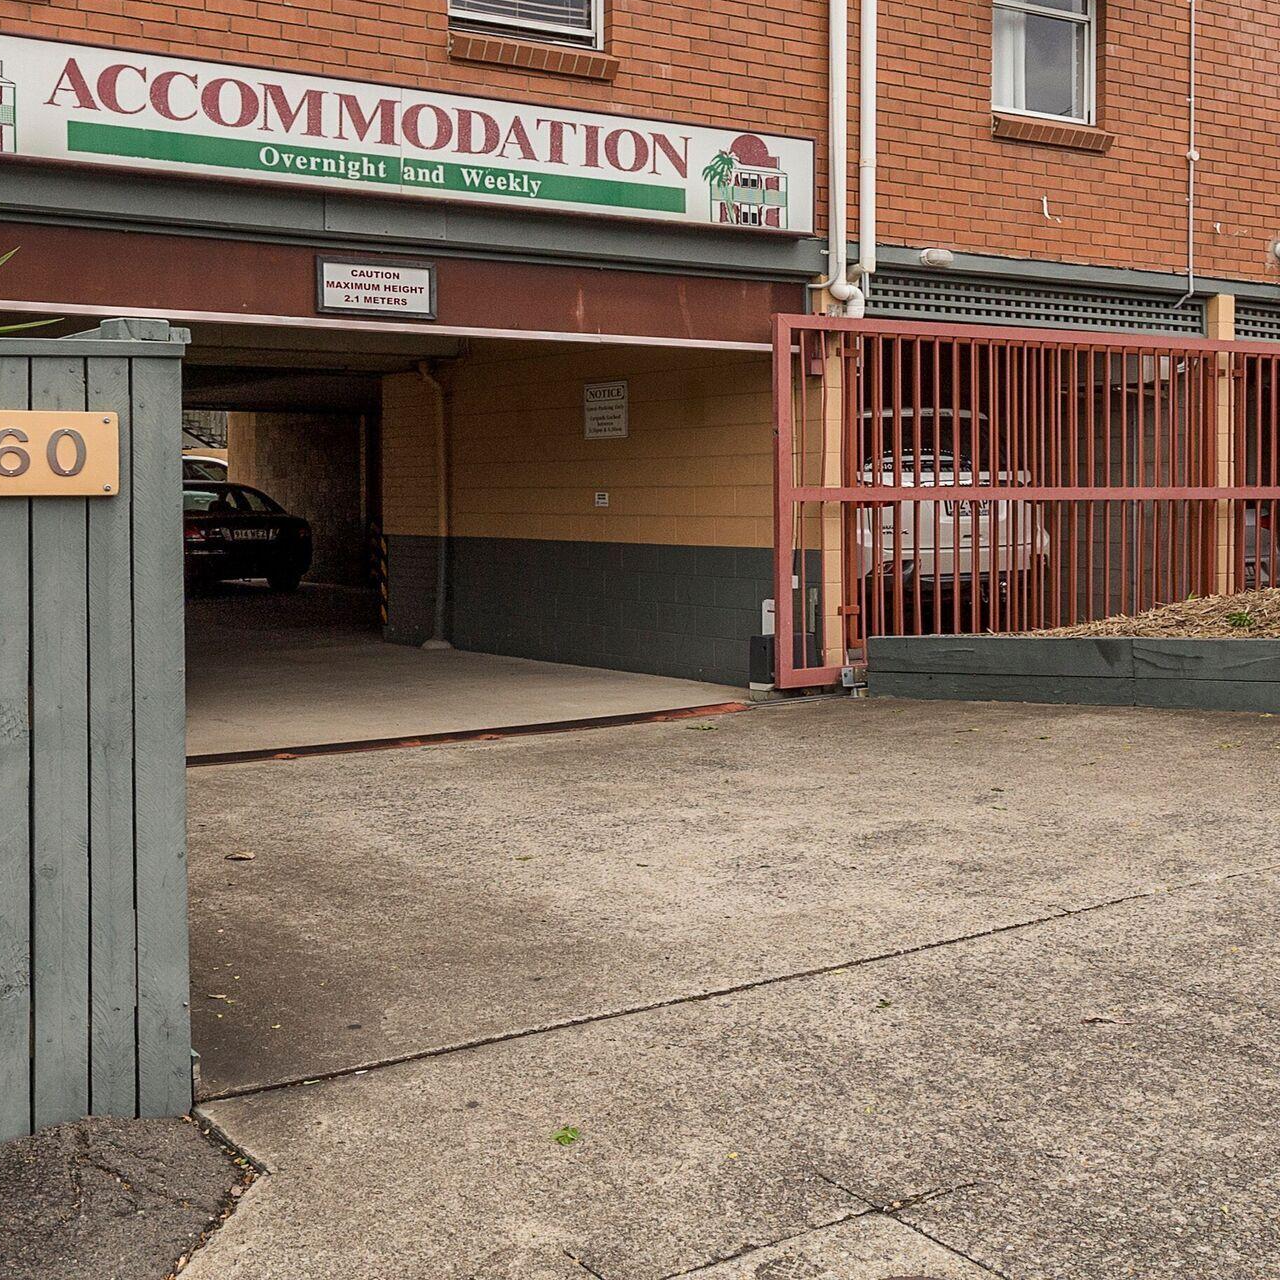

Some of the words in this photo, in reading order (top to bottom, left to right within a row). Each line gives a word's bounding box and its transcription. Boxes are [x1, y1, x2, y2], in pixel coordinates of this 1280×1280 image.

[43, 57, 692, 179] ACCOMMODATION
[258, 146, 387, 180] Overnight
[402, 164, 446, 184] and
[460, 169, 542, 198] Weekly
[350, 269, 401, 280] CAUTION
[326, 280, 381, 292] MAXIMUM
[383, 284, 425, 295] HEIGHT
[344, 294, 360, 303] 2.1
[363, 296, 408, 306] METERS
[588, 387, 623, 400] NOTICE
